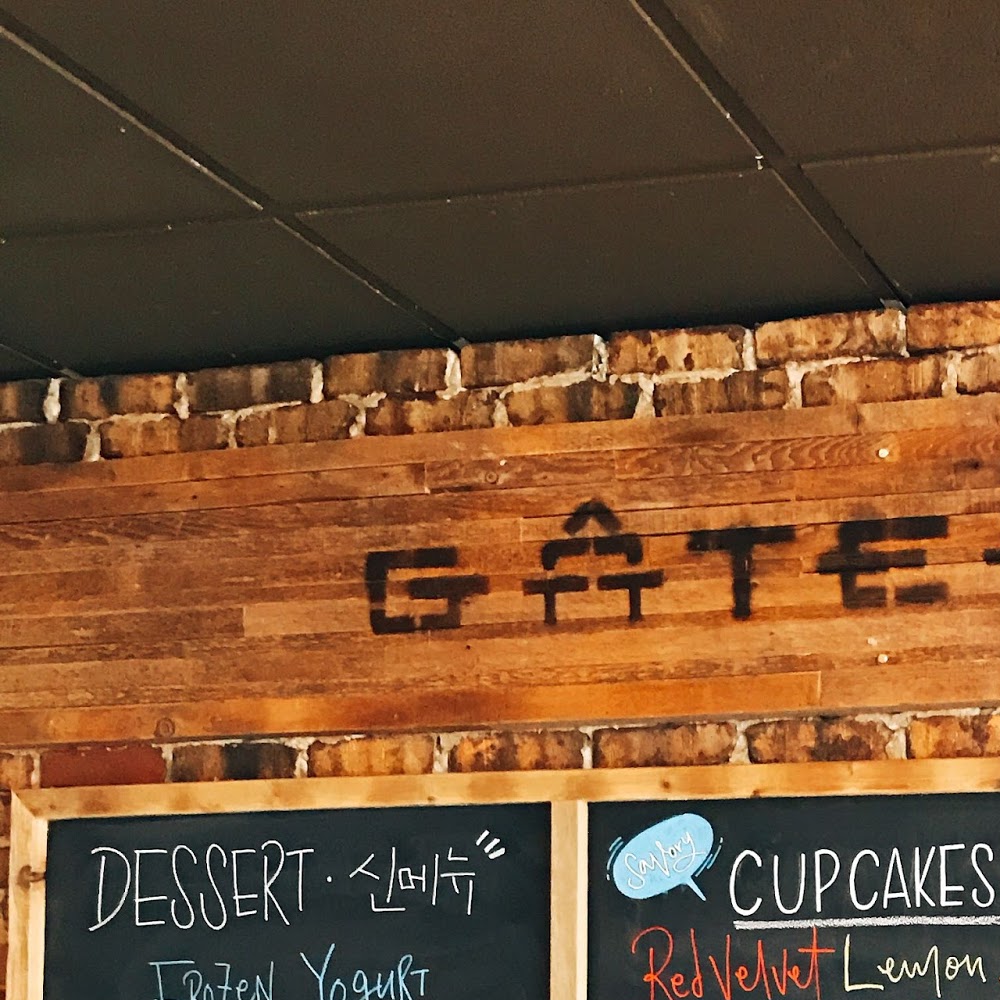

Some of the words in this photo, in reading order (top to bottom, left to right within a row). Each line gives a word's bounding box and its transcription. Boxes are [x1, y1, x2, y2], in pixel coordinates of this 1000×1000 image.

[89, 840, 314, 931] DESSERT
[349, 847, 475, 915] 신메뉴
[729, 843, 995, 916] CUPCAKES
[844, 934, 986, 998] Lemon
